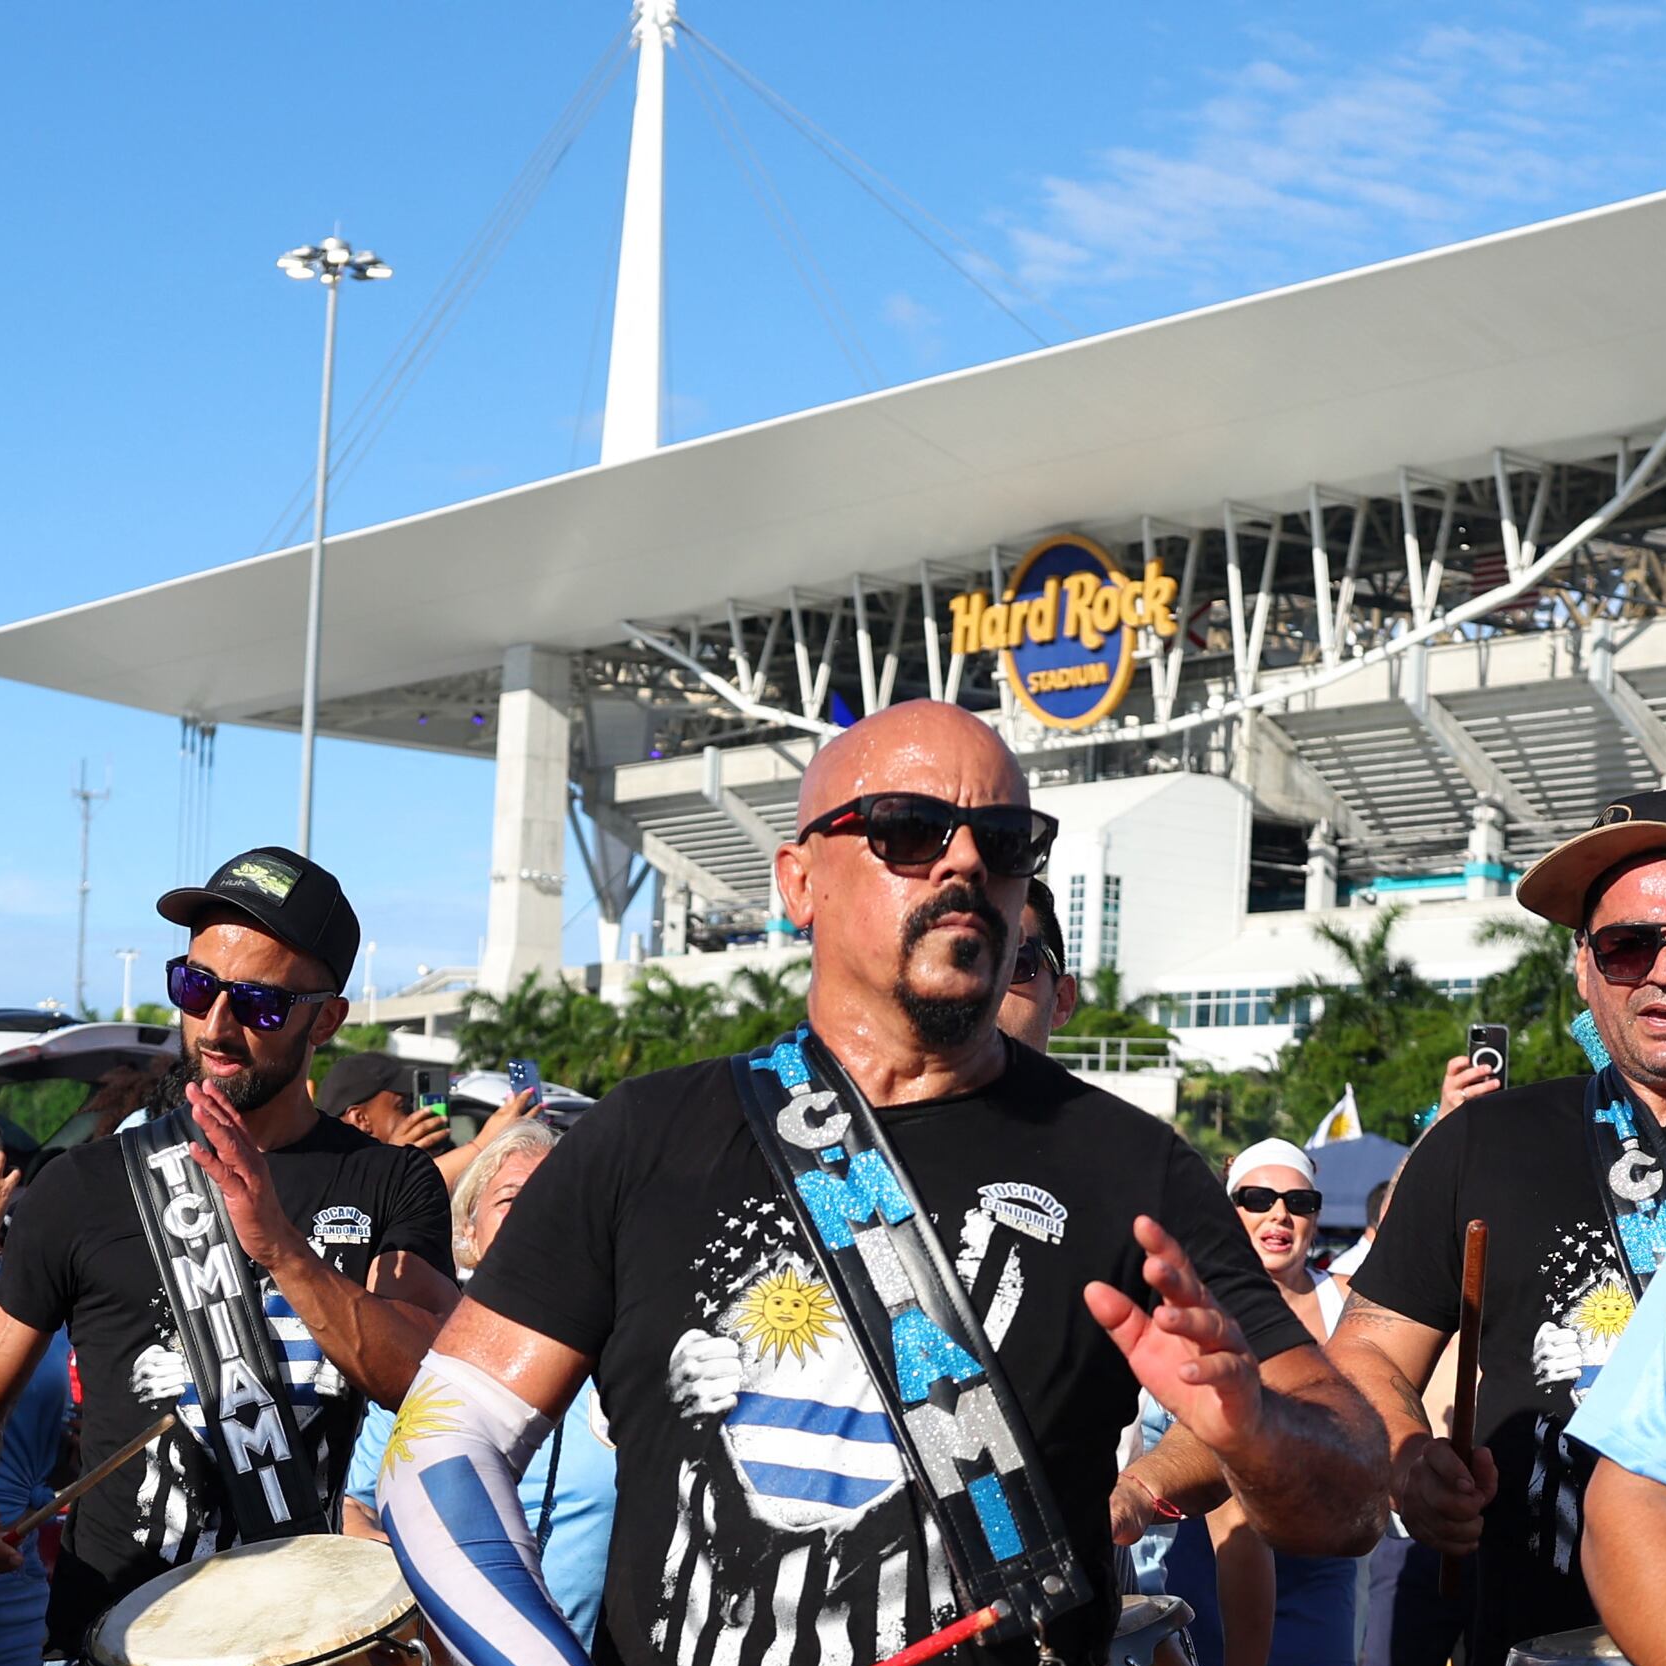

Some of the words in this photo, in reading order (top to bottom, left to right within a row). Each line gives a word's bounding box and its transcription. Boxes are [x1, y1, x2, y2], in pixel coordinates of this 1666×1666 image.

[950, 575, 1061, 654] Hard
[1063, 557, 1179, 650] Rock
[1027, 662, 1109, 694] STADIUM
[313, 1206, 371, 1226] TOCANDO
[978, 1182, 1068, 1221] TOCANDO
[981, 1198, 1064, 1236] CANDOMBE
[314, 1225, 371, 1237] CANDOMBE
